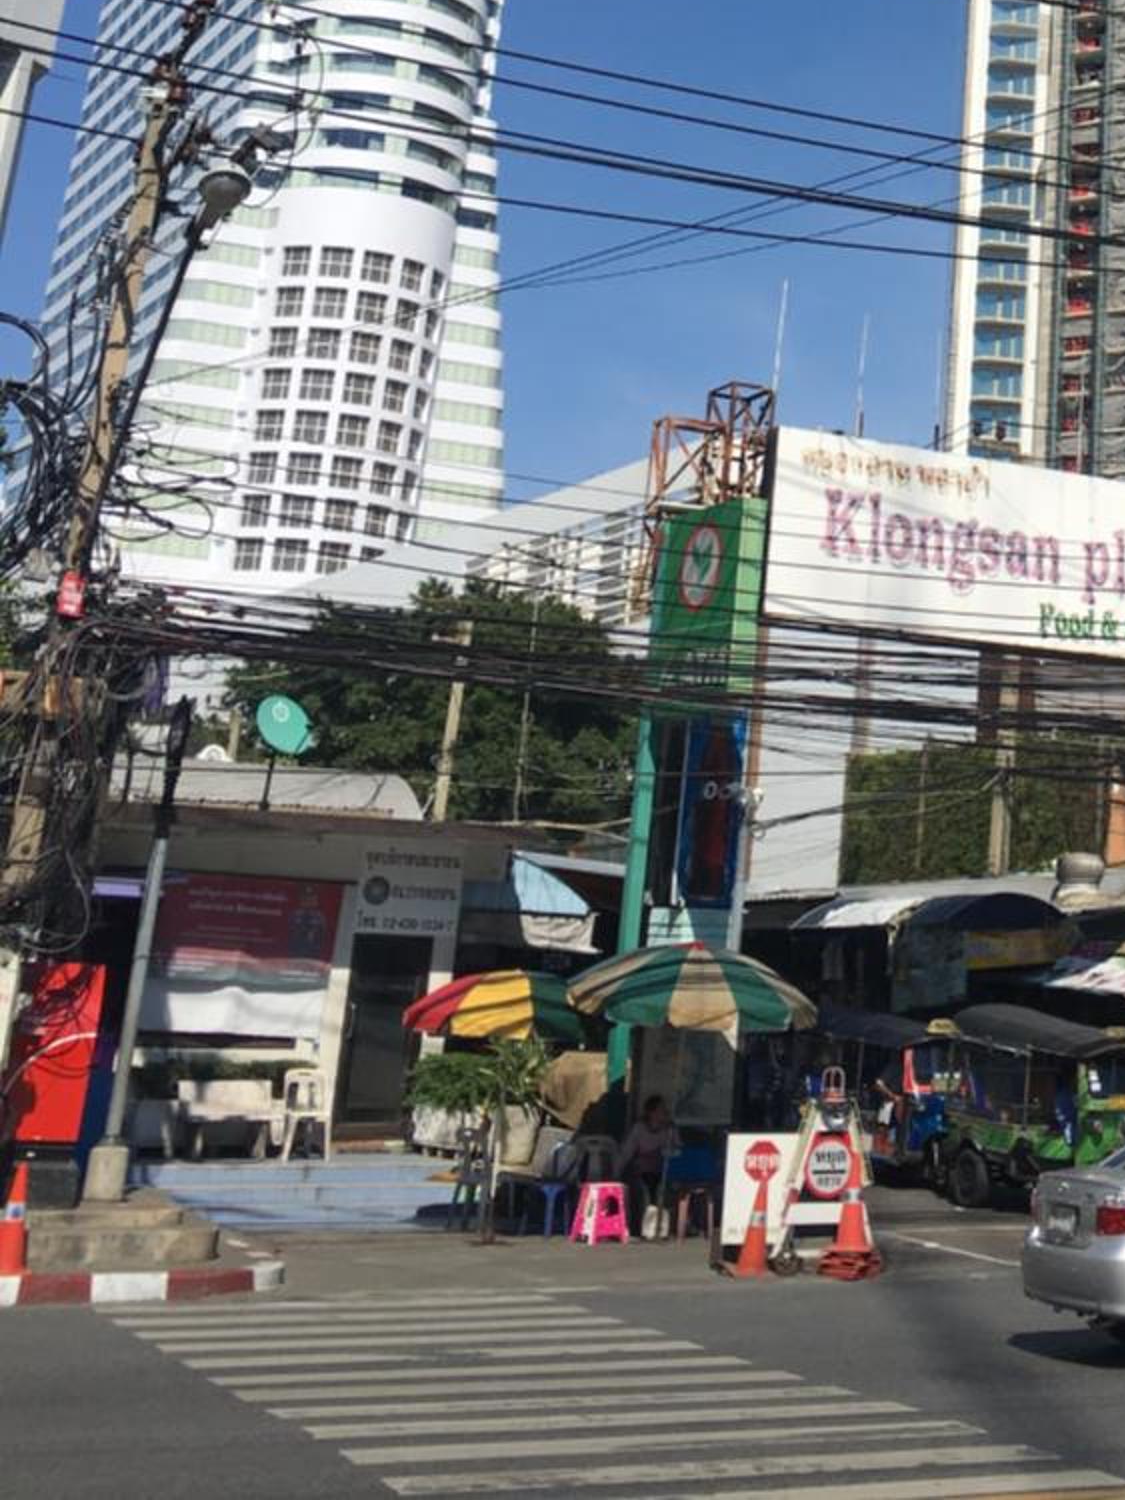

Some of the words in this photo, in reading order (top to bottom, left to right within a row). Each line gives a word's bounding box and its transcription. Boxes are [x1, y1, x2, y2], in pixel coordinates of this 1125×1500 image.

[820, 487, 1061, 596] Klongsan
[1039, 602, 1095, 640] Food
[1102, 610, 1118, 641] &
